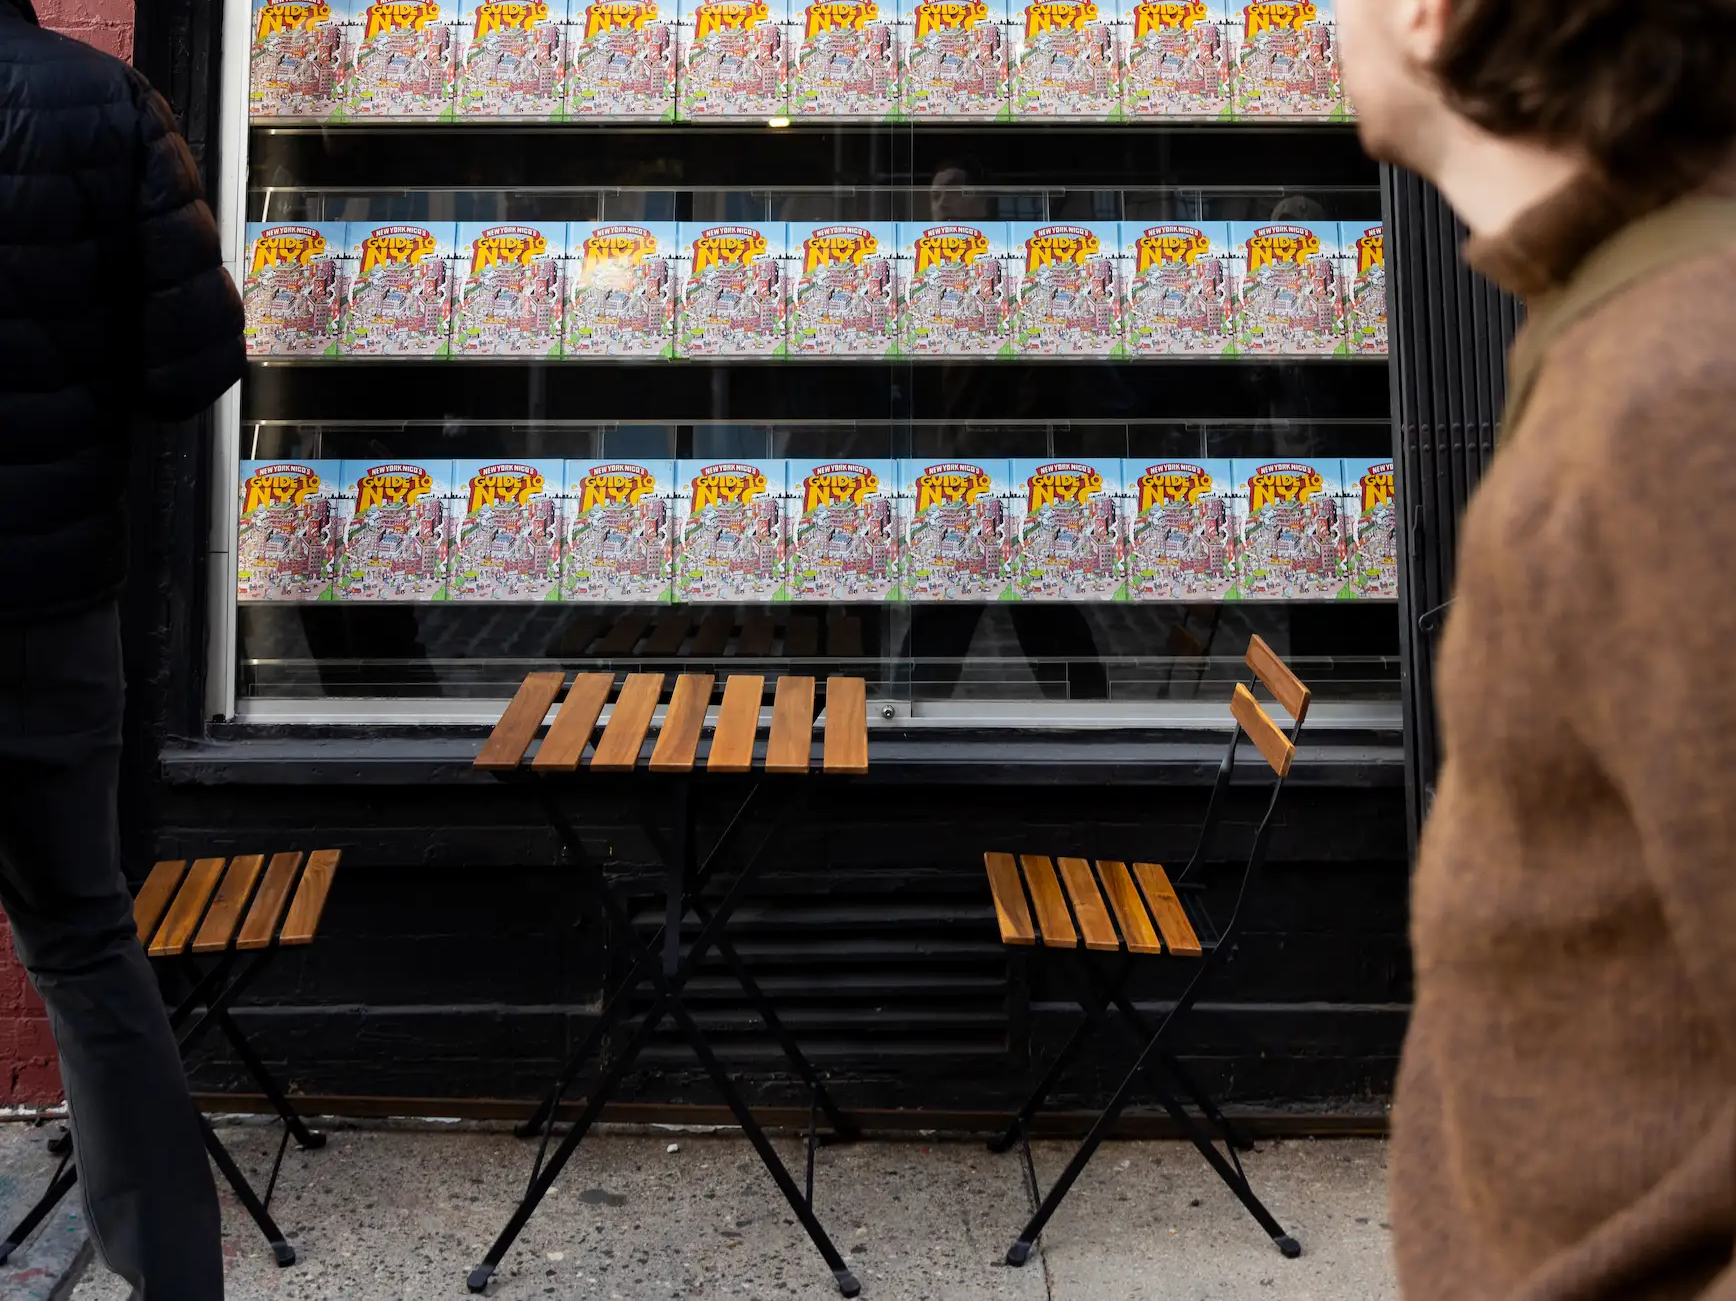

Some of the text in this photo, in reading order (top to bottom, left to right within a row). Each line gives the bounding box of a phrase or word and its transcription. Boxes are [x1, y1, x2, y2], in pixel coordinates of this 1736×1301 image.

[263, 5, 331, 16] GUIDE TO
[481, 3, 549, 15] GUIDE TO
[701, 4, 769, 15] GUIDE TO
[920, 3, 989, 15] GUIDE TO
[1139, 3, 1208, 15] GUIDE TO
[261, 15, 329, 40] NYC
[479, 14, 547, 39] NYC
[699, 14, 767, 39] NYC
[918, 14, 987, 39] NYC
[1137, 14, 1206, 39] NYC
[374, 229, 387, 237] NEW
[387, 226, 404, 234] YORK
[706, 229, 719, 237] NEW
[719, 226, 735, 234] YORK
[817, 229, 830, 237] NEW
[830, 226, 846, 234] YORK
[928, 229, 941, 237] NEW
[941, 226, 957, 234] YORK
[1149, 229, 1162, 237] NEW
[1162, 226, 1178, 234] YORK
[367, 237, 436, 248] GUIDE TO
[698, 237, 768, 249] GUIDE TO
[809, 237, 879, 248] GUIDE TO
[920, 237, 990, 248] GUIDE TO
[1141, 237, 1211, 248] GUIDE TO
[366, 247, 434, 272] NYC
[697, 248, 766, 273] NYC
[808, 247, 877, 272] NYC
[919, 247, 988, 272] NYC
[1140, 247, 1209, 271] NYC
[258, 467, 271, 475] NEW
[272, 465, 289, 473] YORK
[482, 467, 495, 475] NEW
[705, 466, 718, 474] NEW
[719, 464, 735, 472] YORK
[817, 466, 830, 474] NEW
[831, 464, 847, 472] YORK
[929, 466, 942, 474] NEW
[943, 464, 959, 472] YORK
[1041, 466, 1054, 474] NEW
[1151, 466, 1164, 474] NEW
[1164, 464, 1180, 472] YORK
[1372, 463, 1394, 474] NEW YO
[250, 476, 321, 488] GUIDE TO
[474, 475, 545, 488] GUIDE TO
[697, 475, 767, 487] GUIDE TO
[809, 475, 879, 487] GUIDE TO
[921, 475, 991, 487] GUIDE TO
[1033, 474, 1103, 487] GUIDE TO
[1143, 475, 1212, 487] GUIDE TO
[1365, 474, 1394, 486] GUI
[249, 487, 320, 512] NYC
[473, 487, 544, 511] NYC
[696, 486, 766, 511] NYC
[808, 486, 878, 511] NYC
[920, 486, 990, 511] NYC
[1032, 486, 1102, 510] NYC
[1142, 486, 1211, 511] NYC
